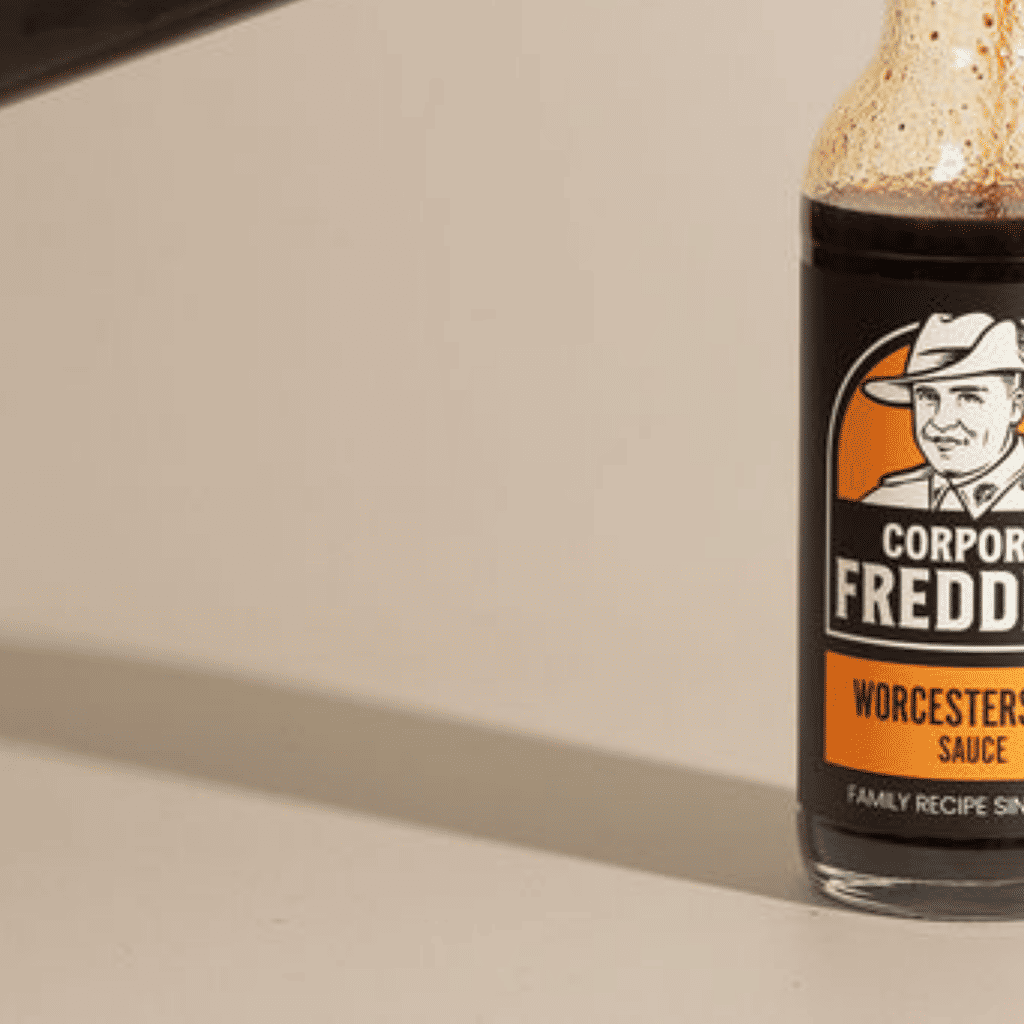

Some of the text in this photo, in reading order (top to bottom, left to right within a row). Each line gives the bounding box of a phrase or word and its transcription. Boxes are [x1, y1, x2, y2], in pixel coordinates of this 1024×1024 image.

[938, 736, 1008, 764] SAUCE
[848, 784, 910, 812] FAMILY
[915, 793, 987, 816] RECIPE
